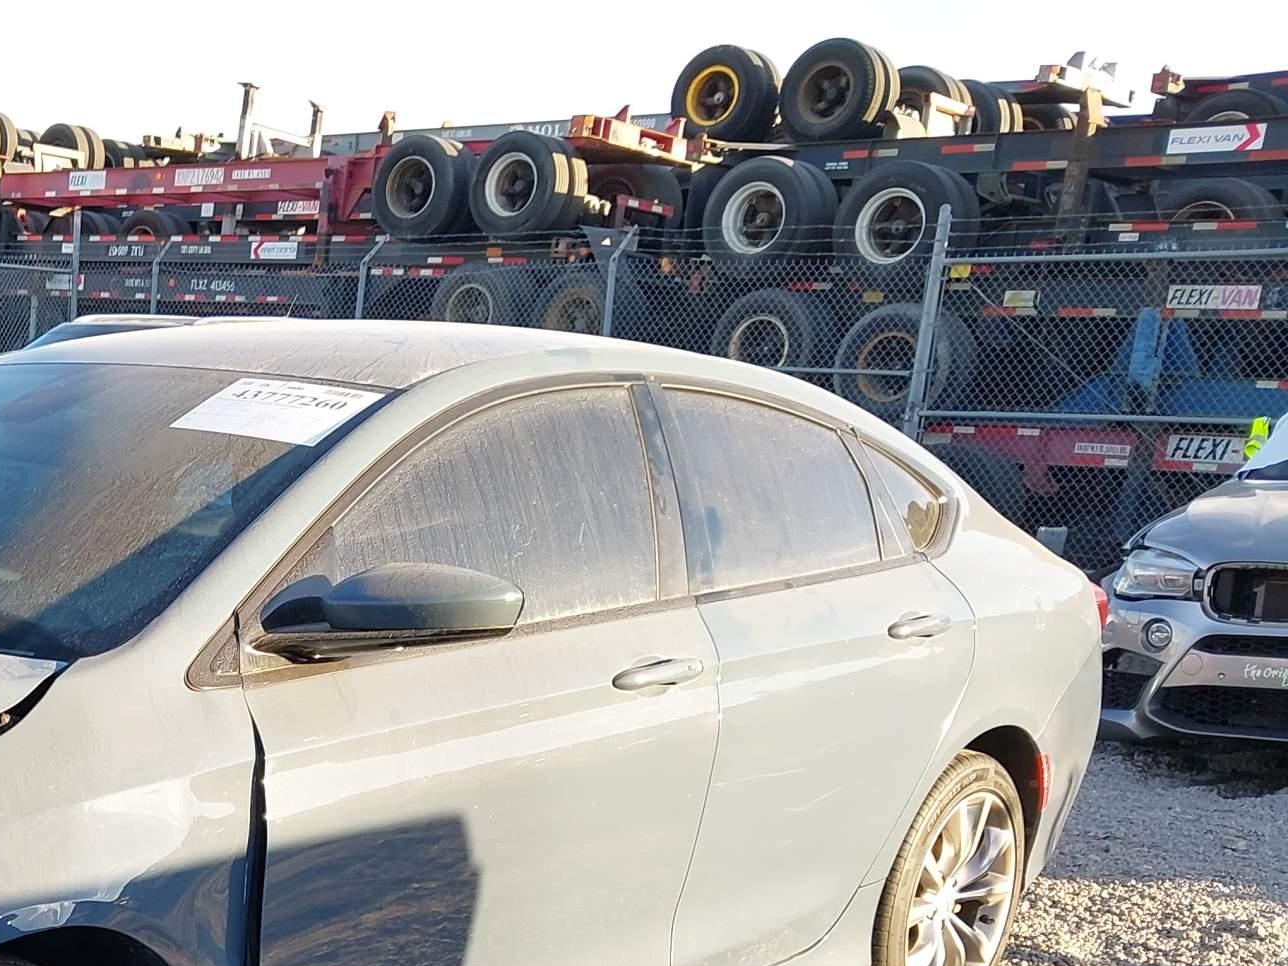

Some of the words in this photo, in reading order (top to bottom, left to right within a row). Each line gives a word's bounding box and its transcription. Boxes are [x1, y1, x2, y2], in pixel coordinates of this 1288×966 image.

[1171, 135, 1211, 145] FLEXI
[1214, 133, 1244, 143] VAN
[1169, 288, 1259, 306] FLEXI-VAN
[232, 389, 348, 411] 43777260
